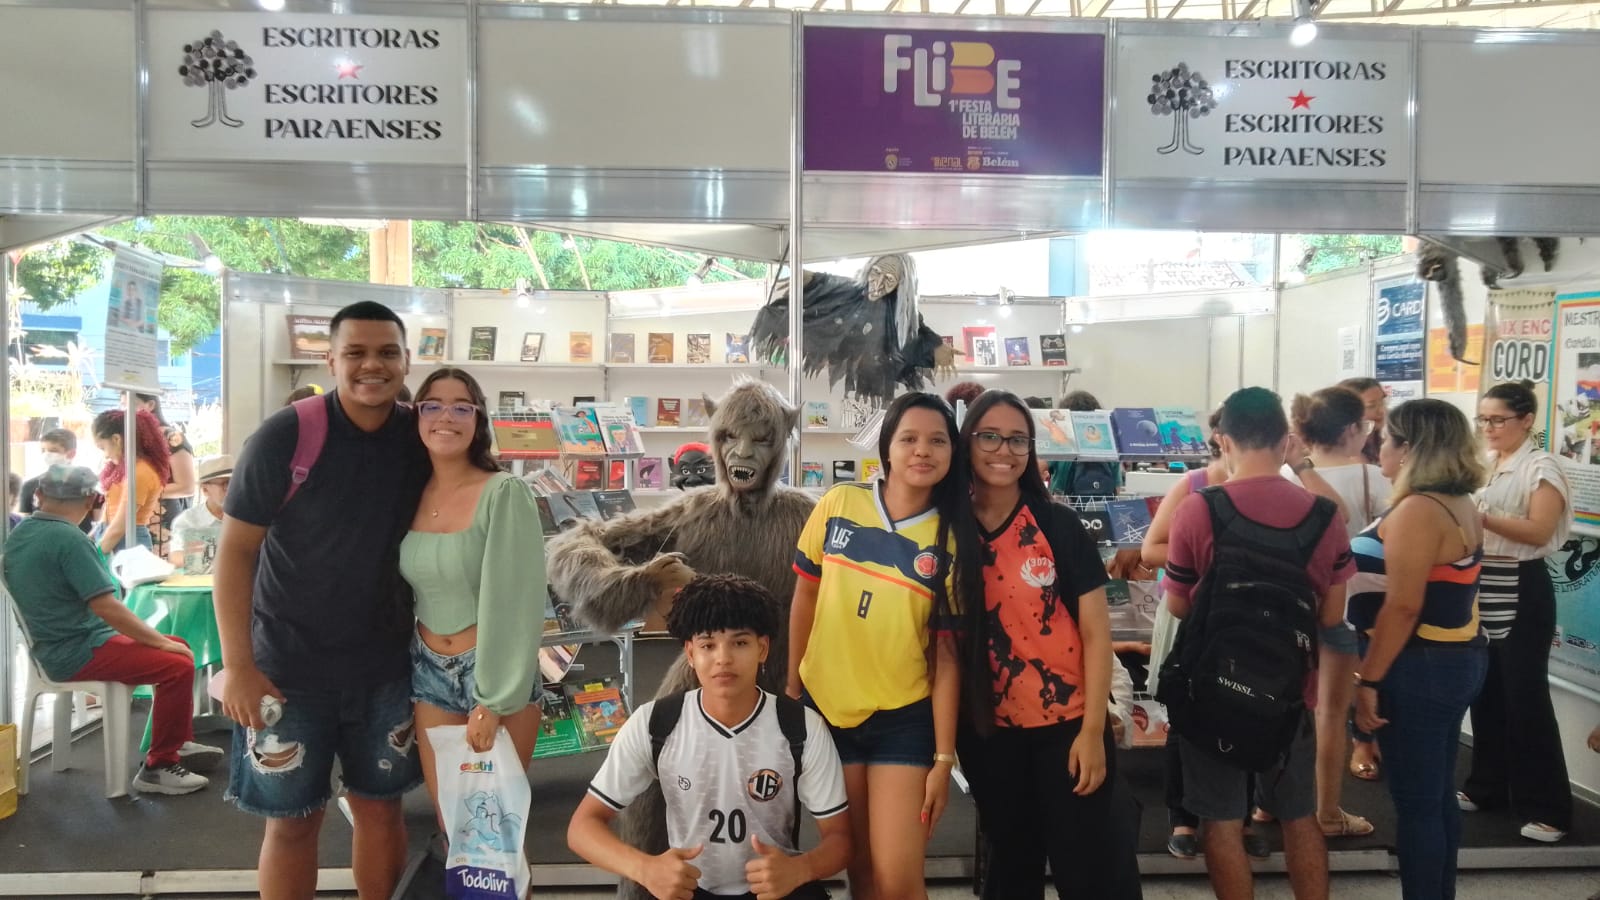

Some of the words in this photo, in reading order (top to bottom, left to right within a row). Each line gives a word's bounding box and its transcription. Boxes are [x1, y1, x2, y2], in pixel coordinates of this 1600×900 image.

[262, 27, 440, 49] ESCRITORAS
[1224, 59, 1387, 82] ESCRITORAS
[264, 84, 438, 105] ESCRITORES
[959, 99, 993, 113] FESTA
[264, 119, 442, 140] PARAENSES
[962, 126, 978, 138] DE
[1224, 114, 1385, 135] ESCRITORES
[1224, 147, 1387, 168] PARAENSES
[1520, 319, 1551, 335] ENC
[708, 808, 747, 844] 20
[457, 869, 509, 893] Todolivr
